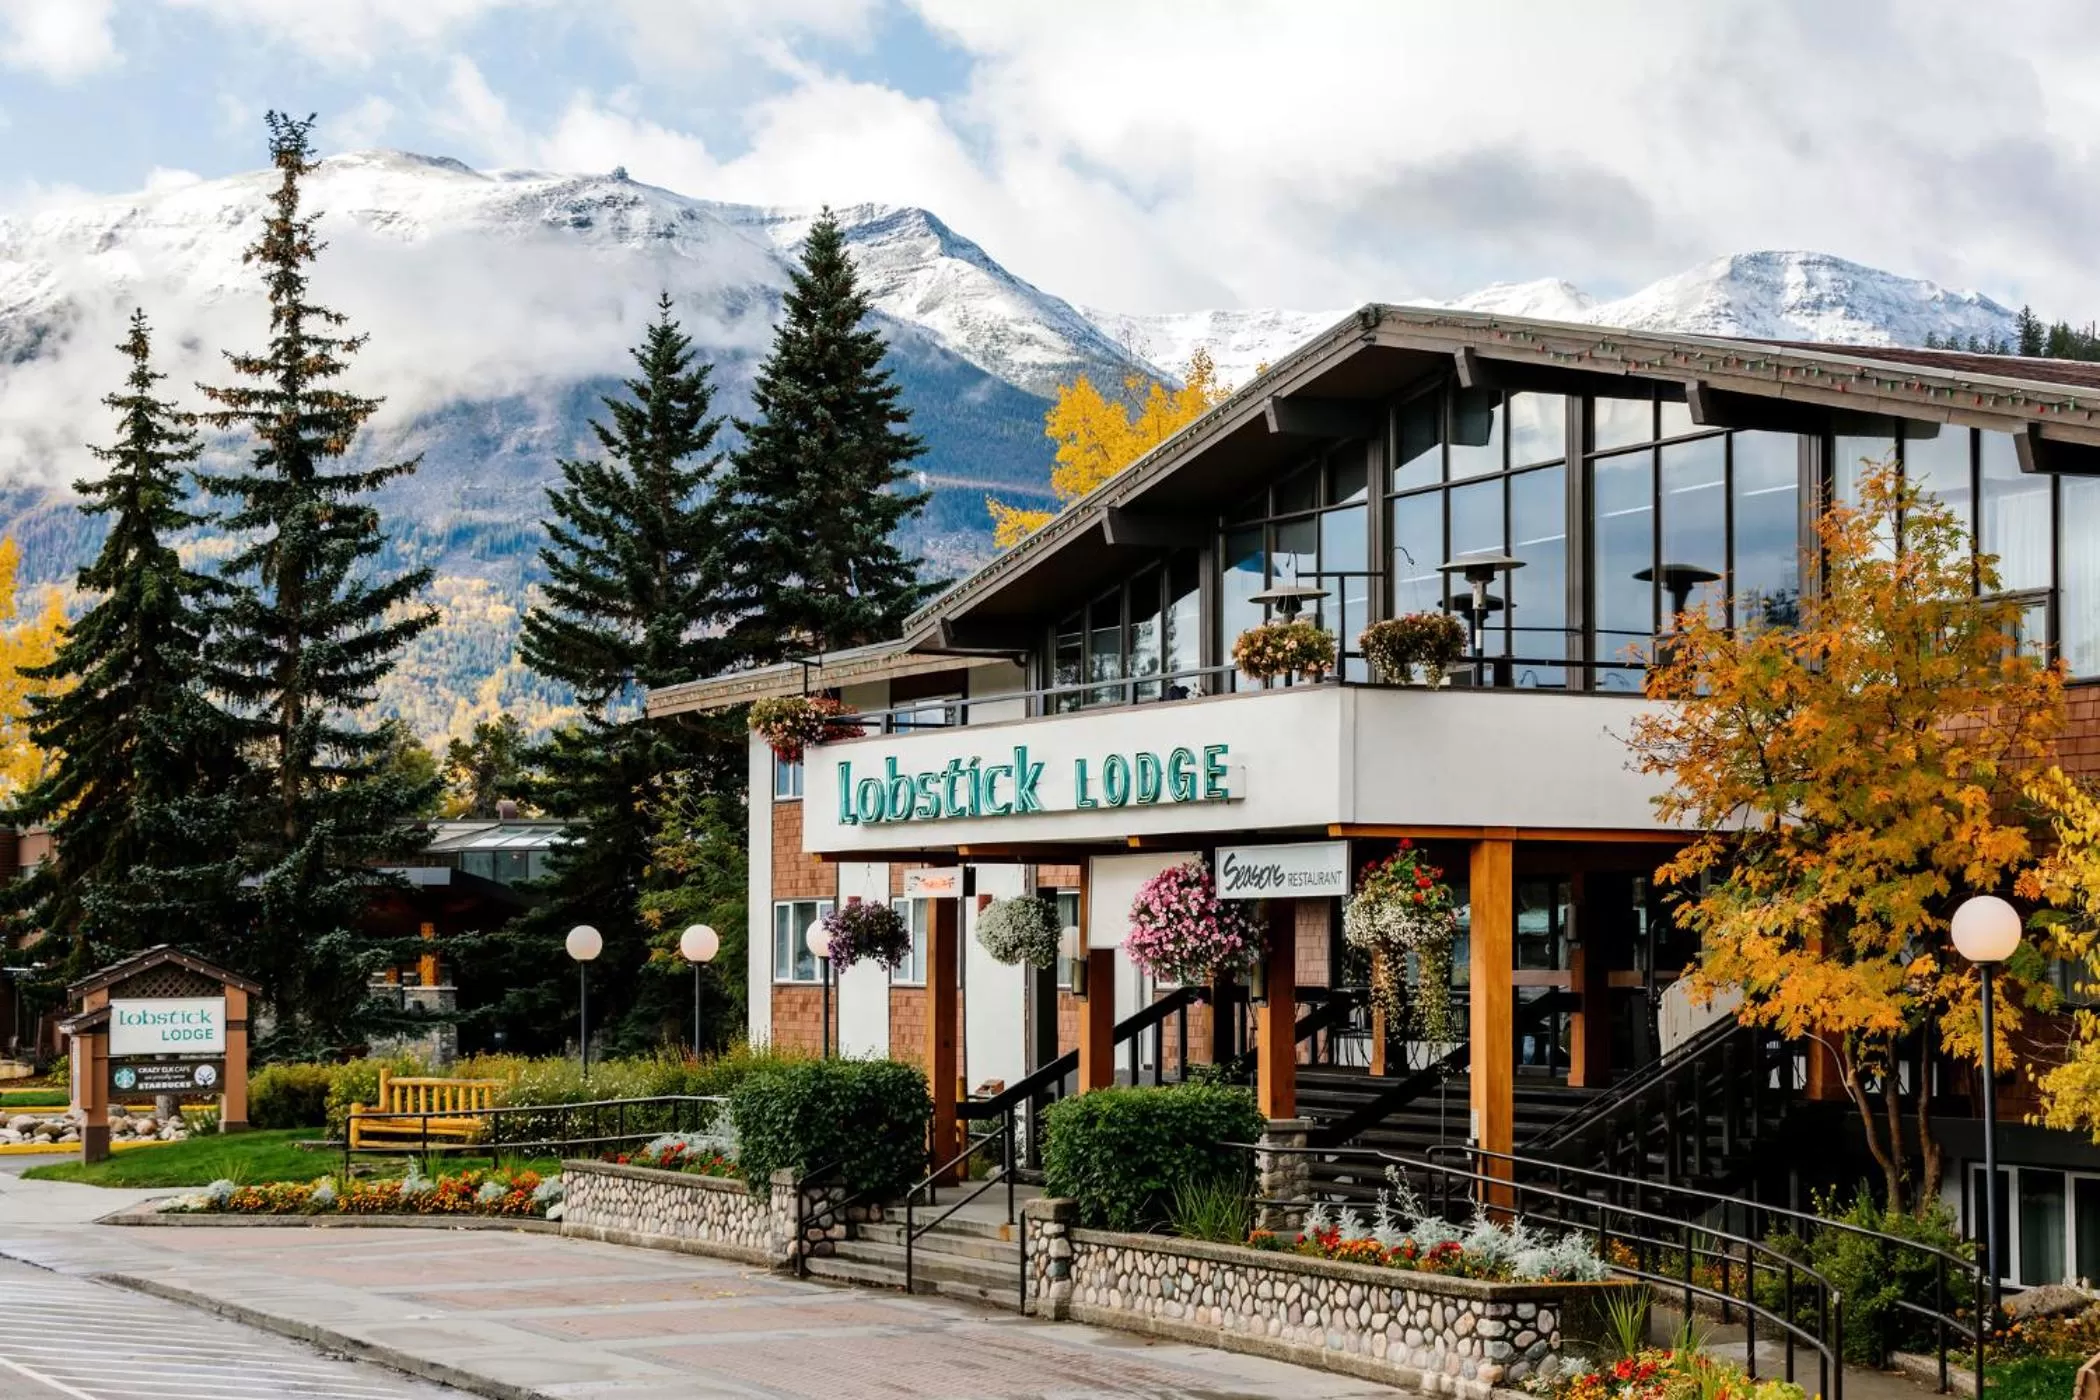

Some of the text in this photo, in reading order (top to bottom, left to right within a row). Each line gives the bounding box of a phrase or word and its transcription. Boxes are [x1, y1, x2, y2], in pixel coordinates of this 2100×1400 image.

[1074, 744, 1230, 810] LODGE
[1223, 852, 1343, 891] Seasons RESTAURANT
[162, 1028, 213, 1041] LODGE
[138, 1081, 192, 1090] STARBUCKS
